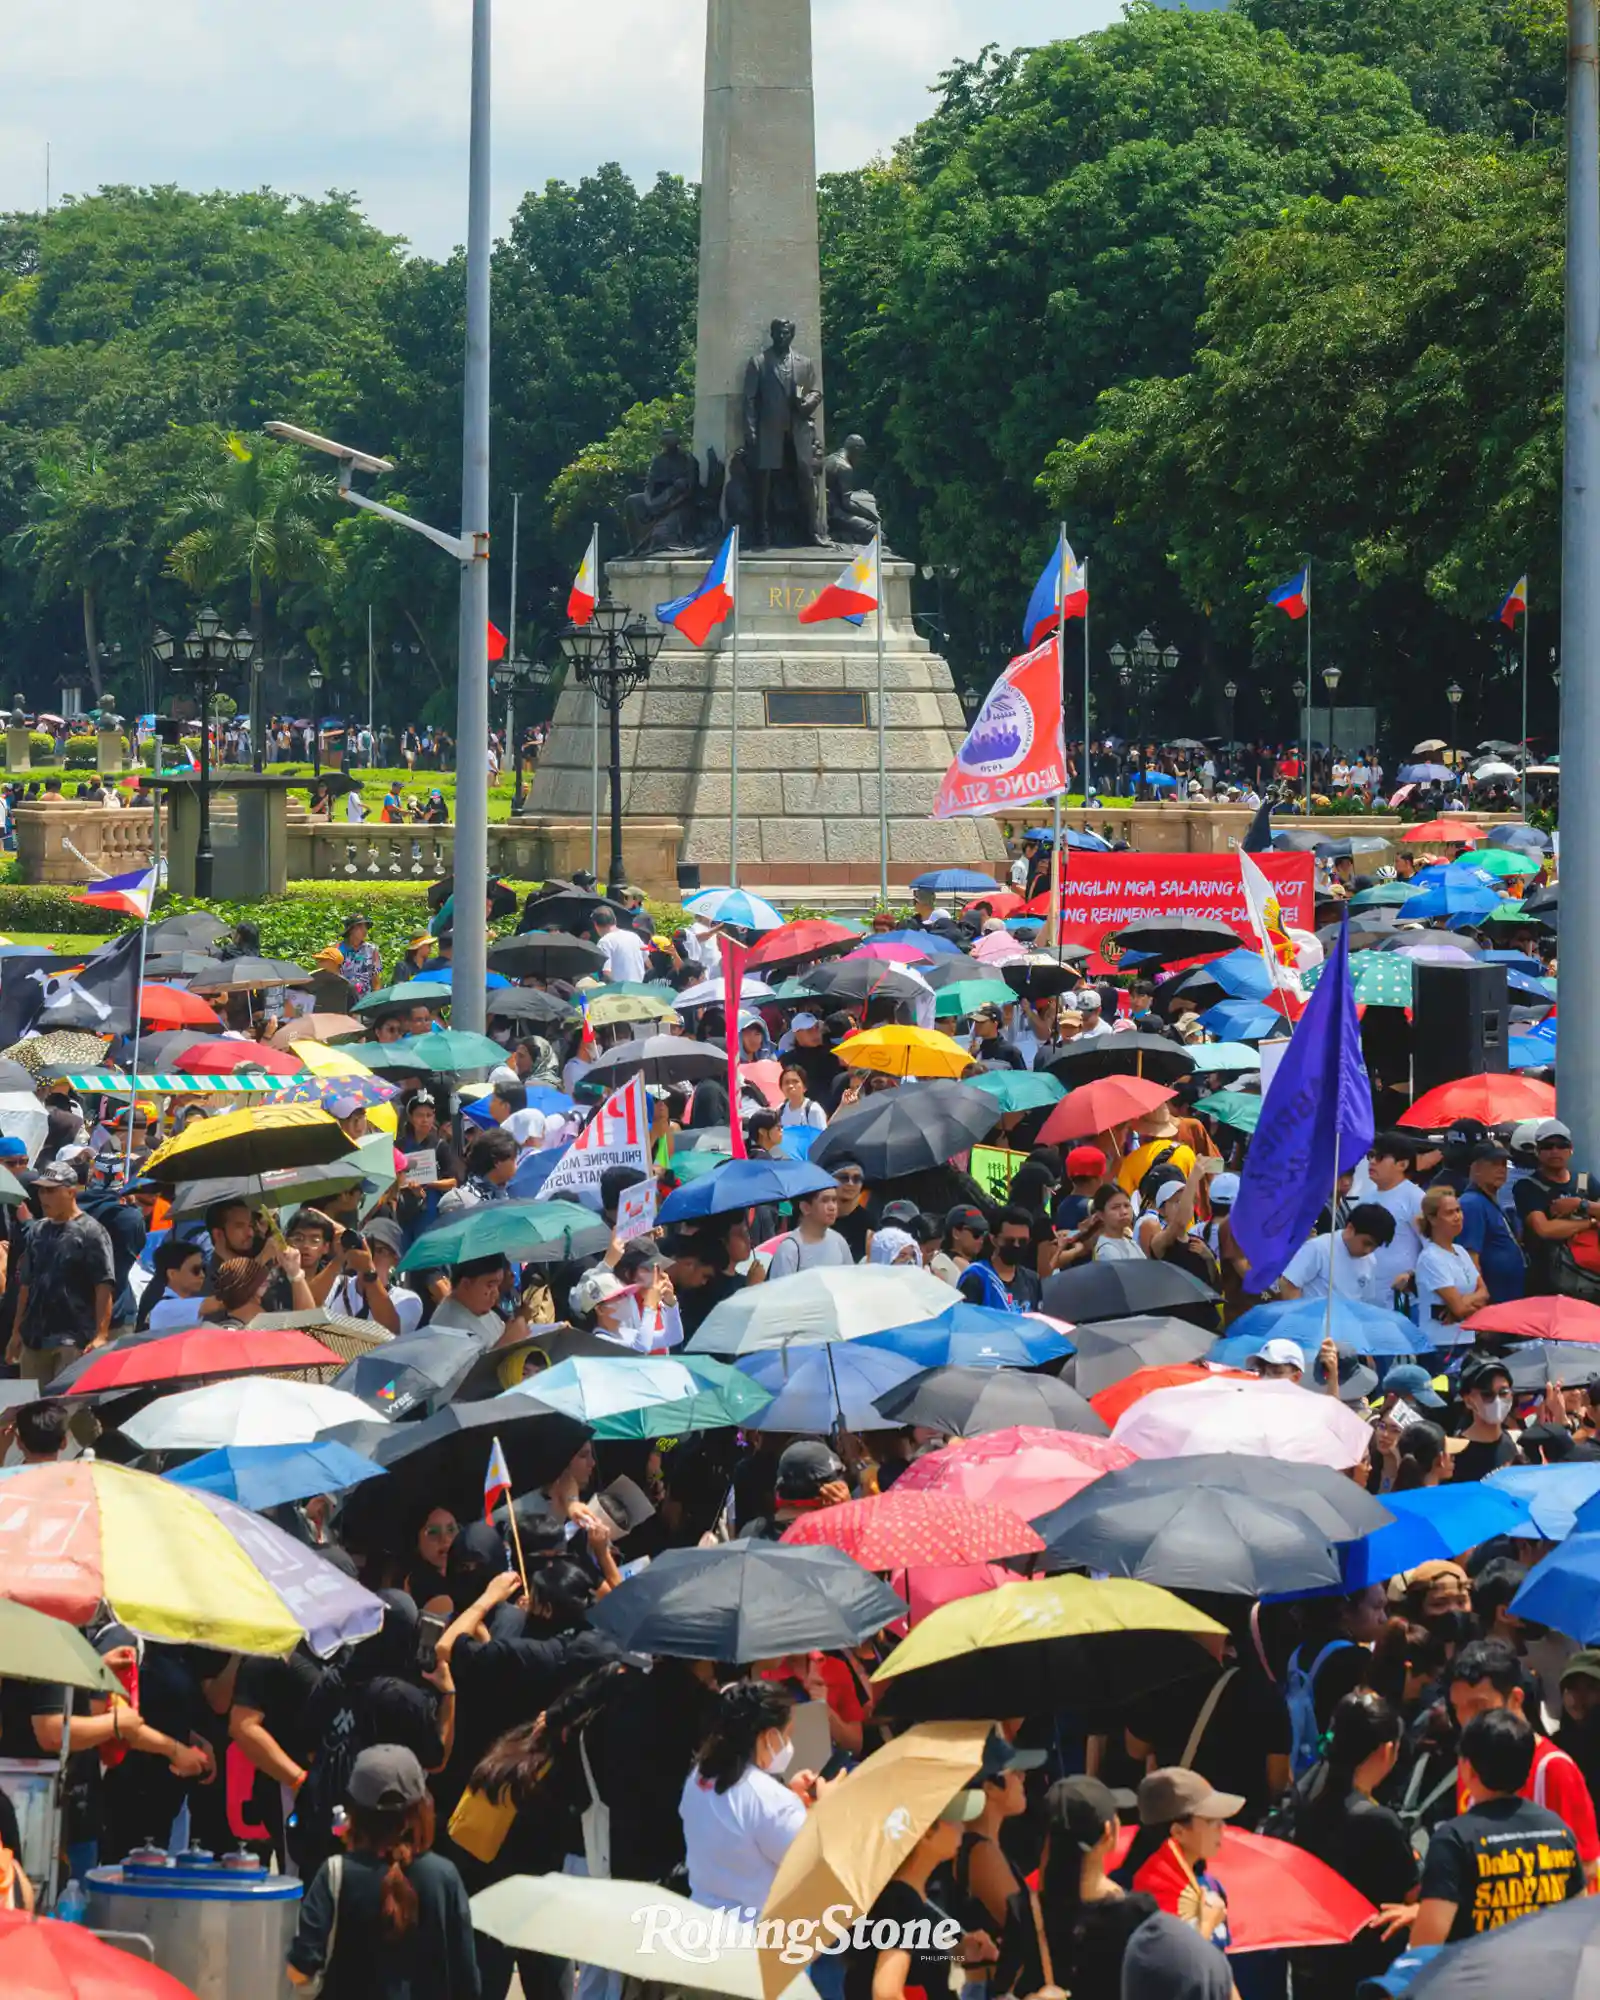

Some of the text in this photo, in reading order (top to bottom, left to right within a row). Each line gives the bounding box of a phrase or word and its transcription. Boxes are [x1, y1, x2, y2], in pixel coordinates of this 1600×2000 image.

[769, 586, 818, 610] RIZA
[1124, 880, 1156, 897] MGA
[1160, 880, 1235, 898] SALARING
[1237, 880, 1307, 897] KKOT
[1091, 907, 1162, 923] REHIMENG
[1165, 907, 1298, 922] MARCOS-DUTE!
